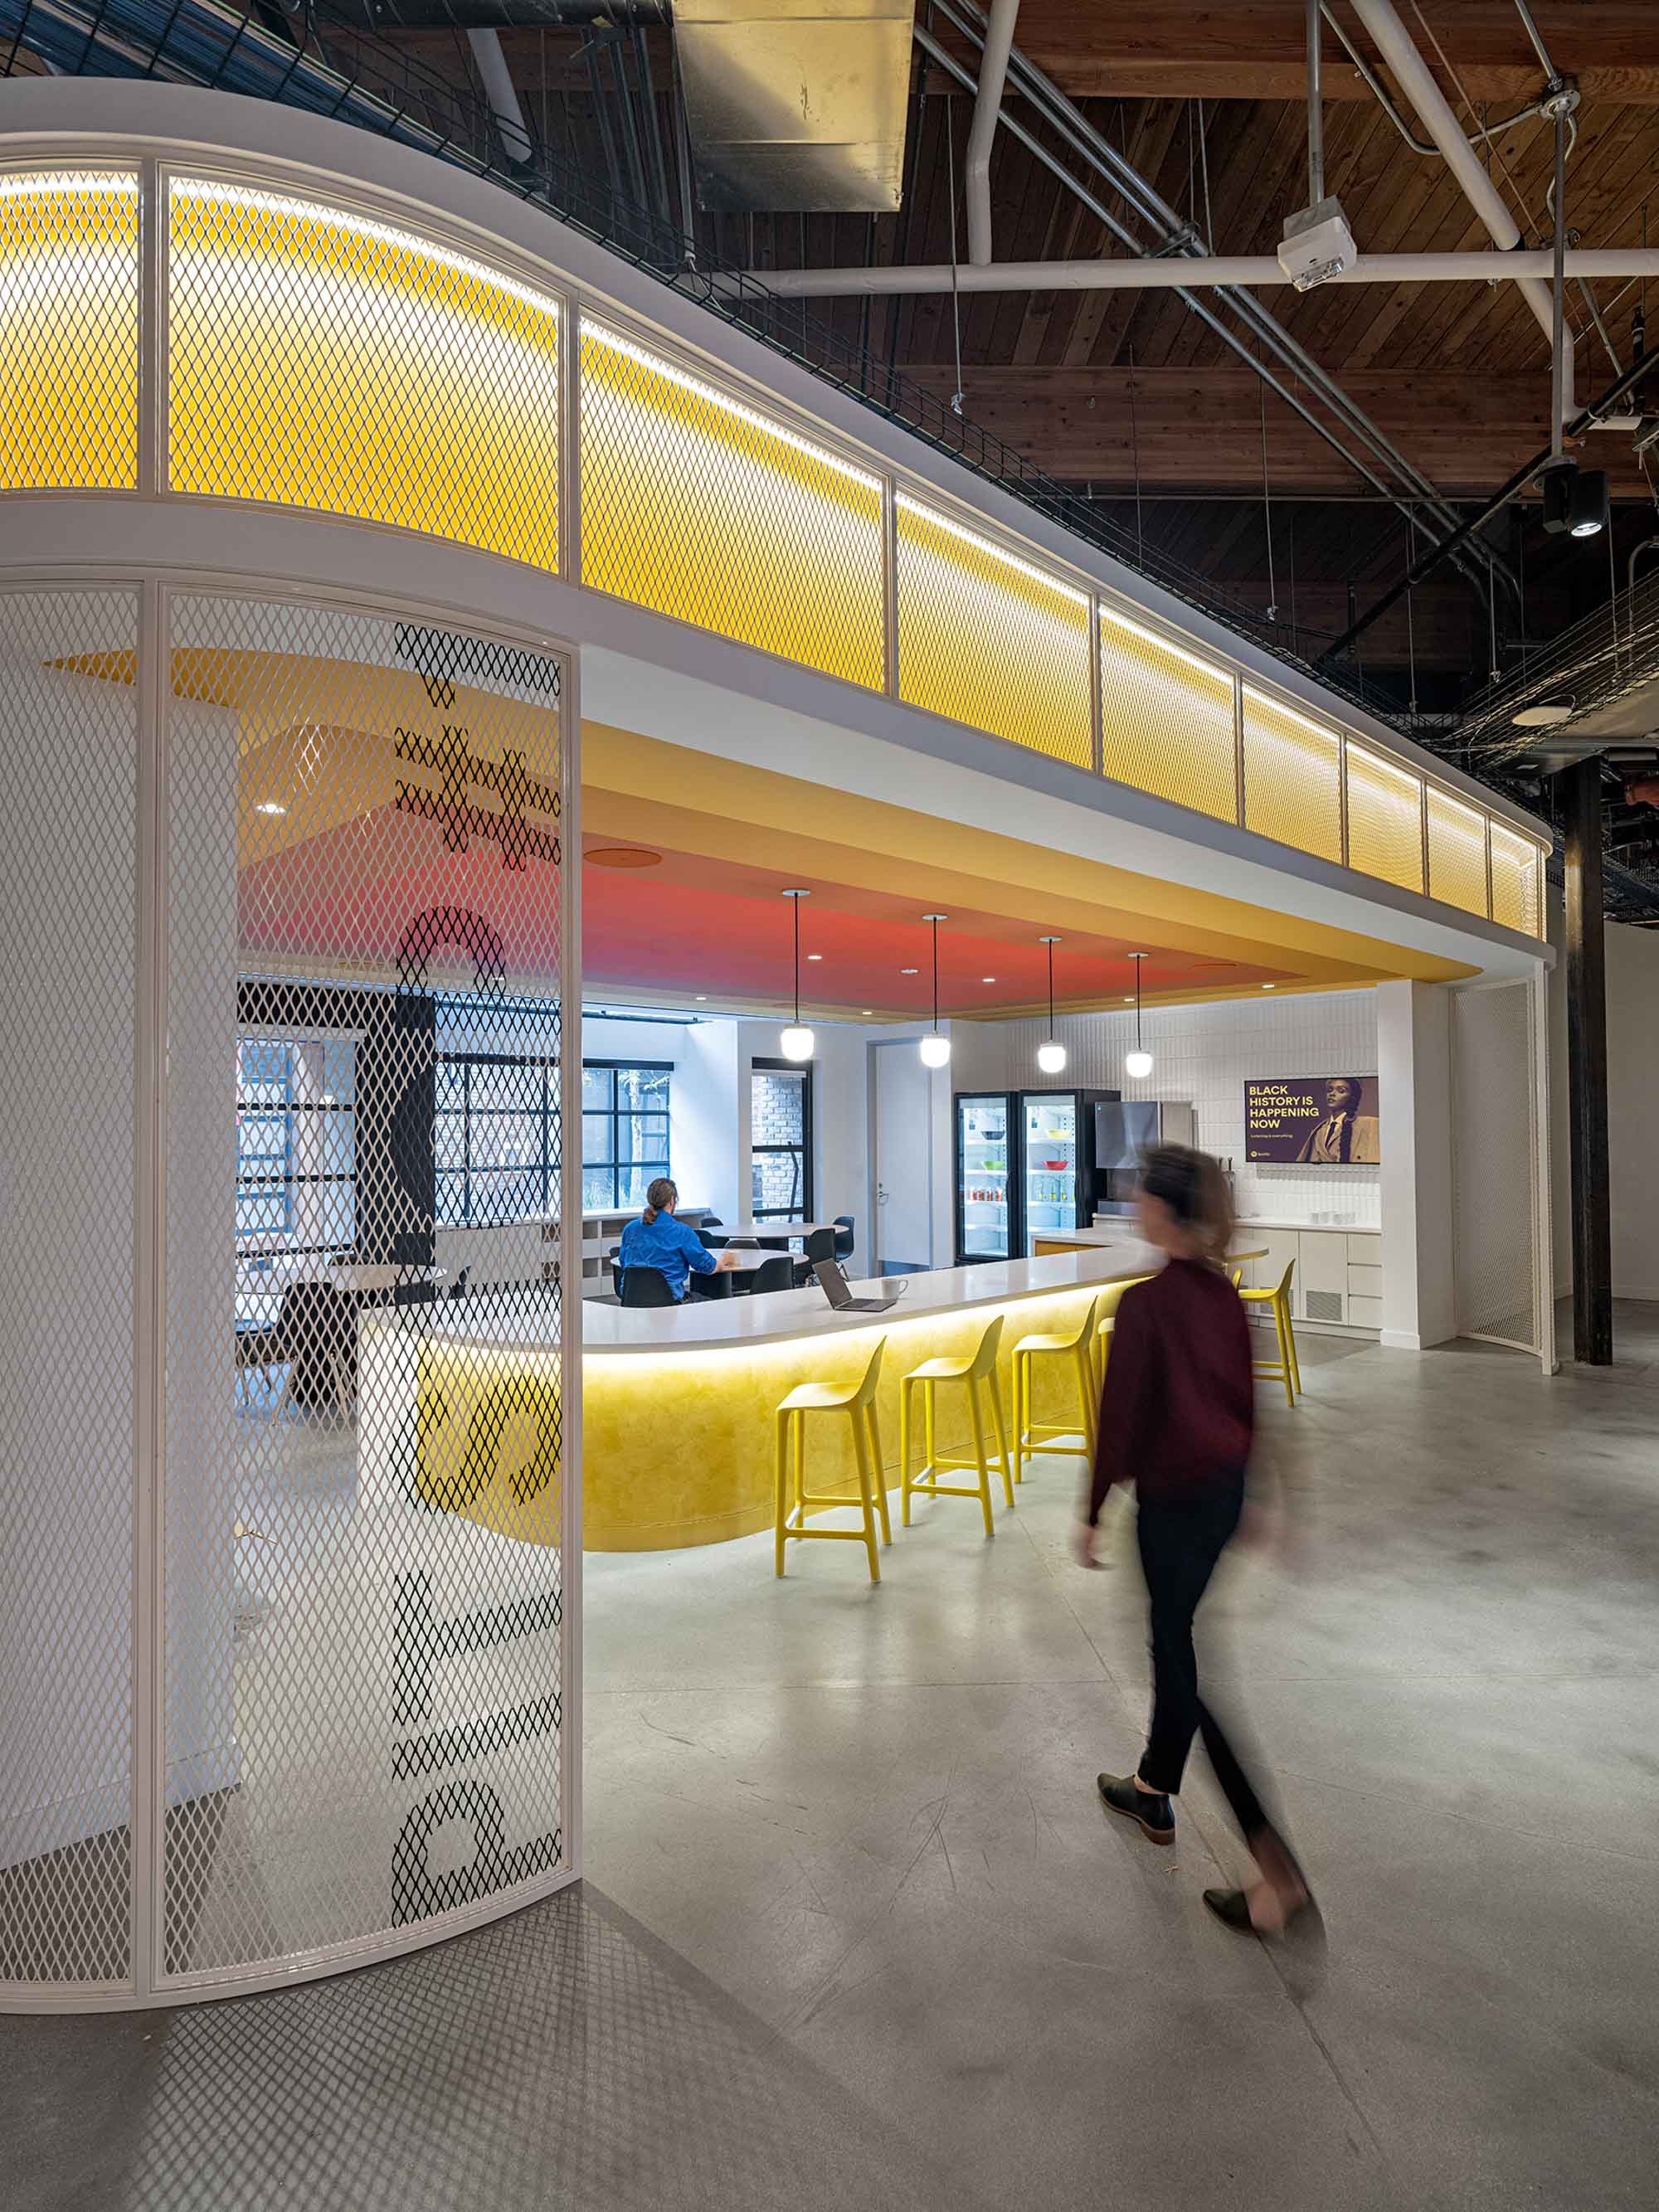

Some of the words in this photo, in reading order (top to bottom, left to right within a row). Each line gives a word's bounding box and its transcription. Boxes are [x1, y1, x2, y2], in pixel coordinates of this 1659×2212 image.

[394, 621, 562, 872] #1
[1248, 1086, 1288, 1095] BLACK
[1249, 1096, 1300, 1106] HISTORY
[1301, 1096, 1314, 1106] IS
[1250, 1107, 1320, 1117] HAPPENING
[1250, 1119, 1281, 1129] NOW
[389, 906, 562, 1516] STOP
[392, 1570, 562, 1928] PIT
